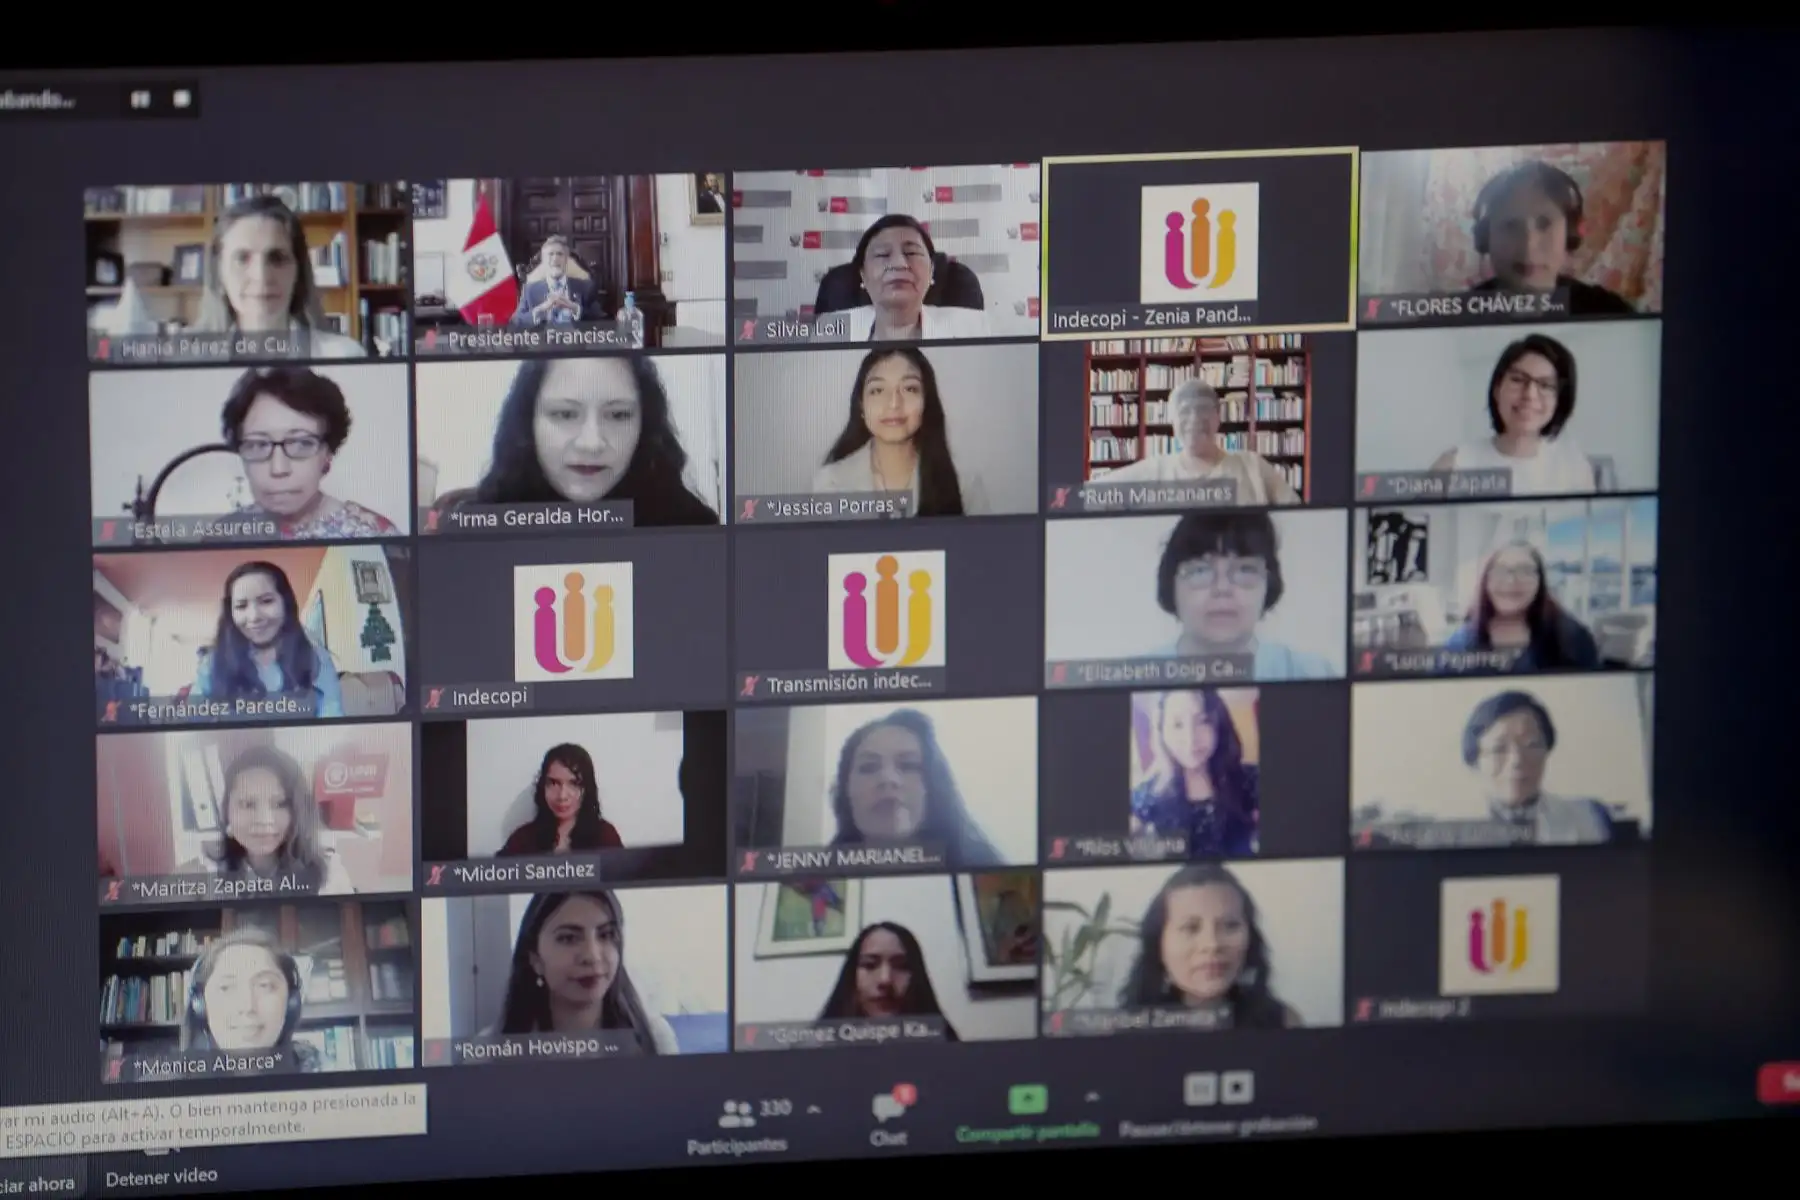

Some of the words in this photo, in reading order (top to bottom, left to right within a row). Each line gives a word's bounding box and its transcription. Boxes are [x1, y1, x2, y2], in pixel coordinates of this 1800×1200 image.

[1468, 293, 1535, 312] CHÁVEZ
[766, 320, 809, 337] Silvia
[814, 319, 845, 336] Loli
[1053, 311, 1127, 330] Indecopi
[1145, 309, 1190, 325] Zenia
[1196, 307, 1251, 323] Pand...
[179, 338, 230, 356] Pérez
[235, 336, 257, 353] de
[449, 331, 539, 348] Presidente
[546, 328, 627, 345] Francisc...
[1129, 485, 1233, 503] Manzanares
[1448, 475, 1507, 494] Zapata
[839, 498, 894, 514] Porras
[503, 508, 572, 526] Geralda
[578, 507, 624, 524] Hor...
[192, 519, 276, 537] Assureira
[1165, 661, 1207, 679] Doig
[767, 675, 868, 693] Transmisión
[453, 687, 528, 708] Indecopi
[525, 861, 595, 880] Sanchez
[213, 878, 273, 897] Zapata
[839, 1023, 901, 1044] Quispe
[528, 1038, 600, 1057] Hovispo
[25, 1111, 45, 1127] mi
[51, 1109, 96, 1125] audio
[101, 1105, 165, 1124] (Alt+A).
[170, 1104, 183, 1118] O
[188, 1102, 222, 1118] bien
[227, 1100, 307, 1116] mantenga
[313, 1092, 398, 1113] presionada
[404, 1091, 416, 1105] la
[6, 1131, 76, 1149] ESPACIO
[81, 1131, 116, 1149] para
[121, 1125, 173, 1143] activar
[178, 1120, 306, 1142] temporalmente.
[870, 1129, 908, 1147] Chat
[687, 1138, 788, 1156] Participantes
[29, 1175, 75, 1193] ahora
[106, 1171, 170, 1188] Detener
[174, 1167, 218, 1184] video
